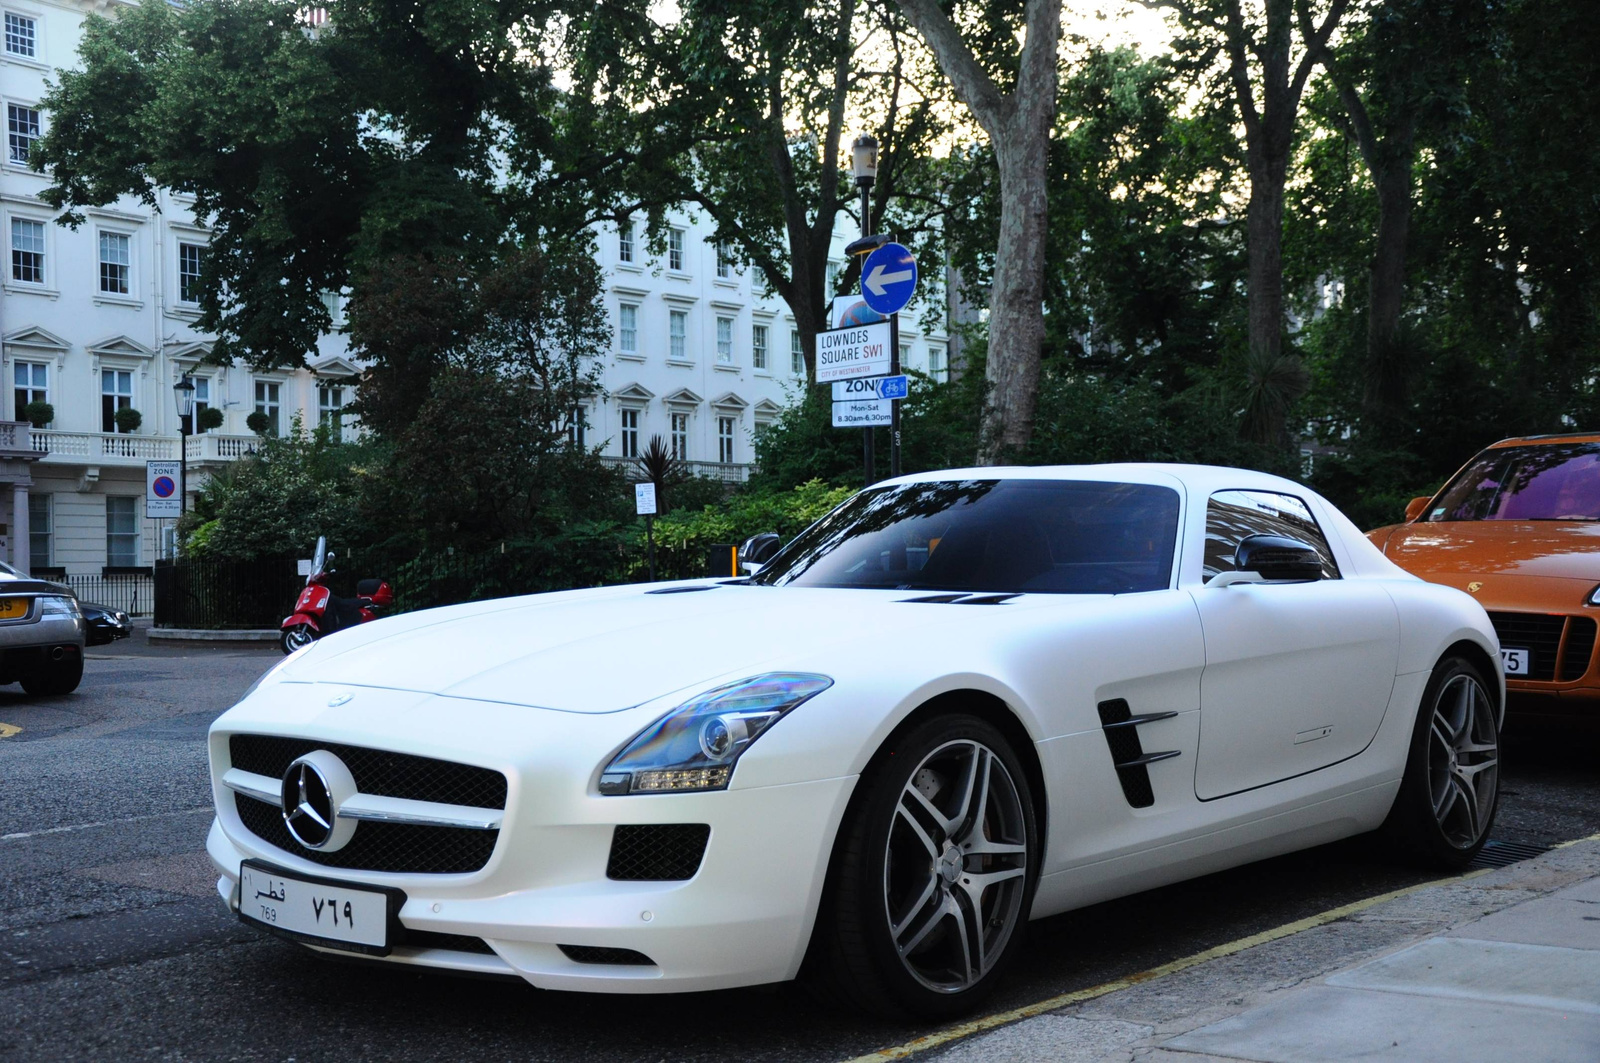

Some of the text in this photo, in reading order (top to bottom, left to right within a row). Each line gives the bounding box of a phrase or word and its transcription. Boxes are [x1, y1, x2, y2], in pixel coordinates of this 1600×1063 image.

[821, 330, 869, 349] LOWNDES
[821, 343, 883, 365] SQUARE SW1
[821, 365, 871, 378] CITY OF WESTMINSTER
[845, 379, 878, 393] ZON
[254, 879, 286, 902] قطر
[260, 904, 277, 922] 769
[312, 896, 354, 929] ٧٦٩
